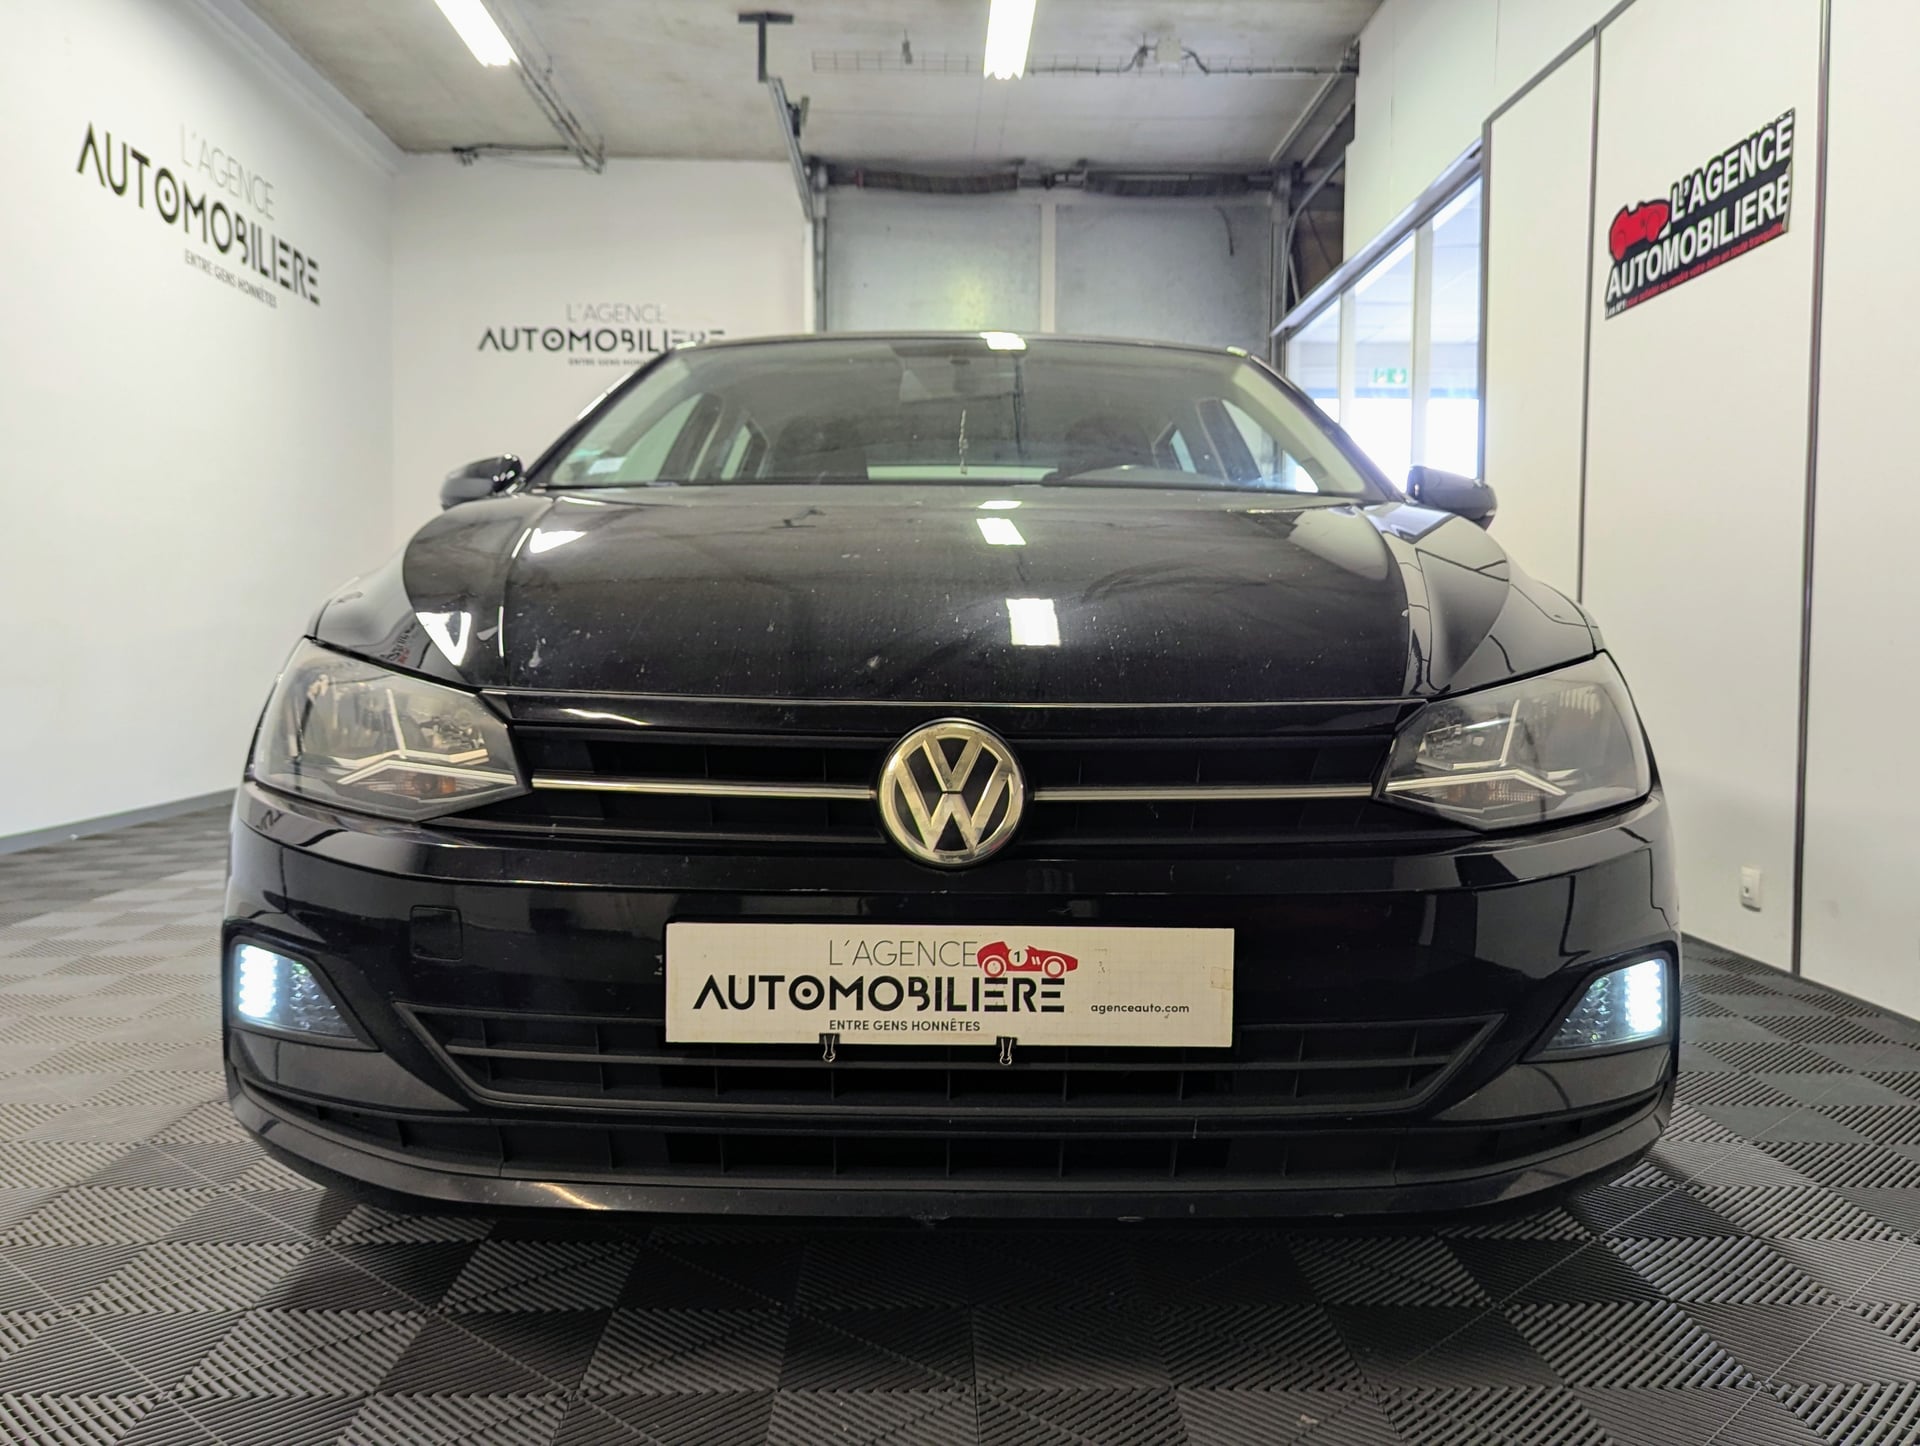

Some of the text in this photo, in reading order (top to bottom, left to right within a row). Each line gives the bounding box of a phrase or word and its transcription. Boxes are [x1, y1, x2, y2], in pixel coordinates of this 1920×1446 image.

[180, 123, 275, 221] L'AGENCE
[1671, 115, 1793, 222] L'AGENCE
[76, 121, 320, 306] AUTOMOBILIERE
[1606, 172, 1790, 302] AUTOMOBILIERE
[566, 303, 668, 324] L'AGENCE
[829, 940, 979, 967] L'AGENCE
[1014, 951, 1021, 963] 1
[693, 974, 1065, 1013] AUTOMOBILIERE
[1090, 1003, 1190, 1015] agenceauto.com
[829, 1018, 981, 1032] ENTRE GENS HONNÊTES
